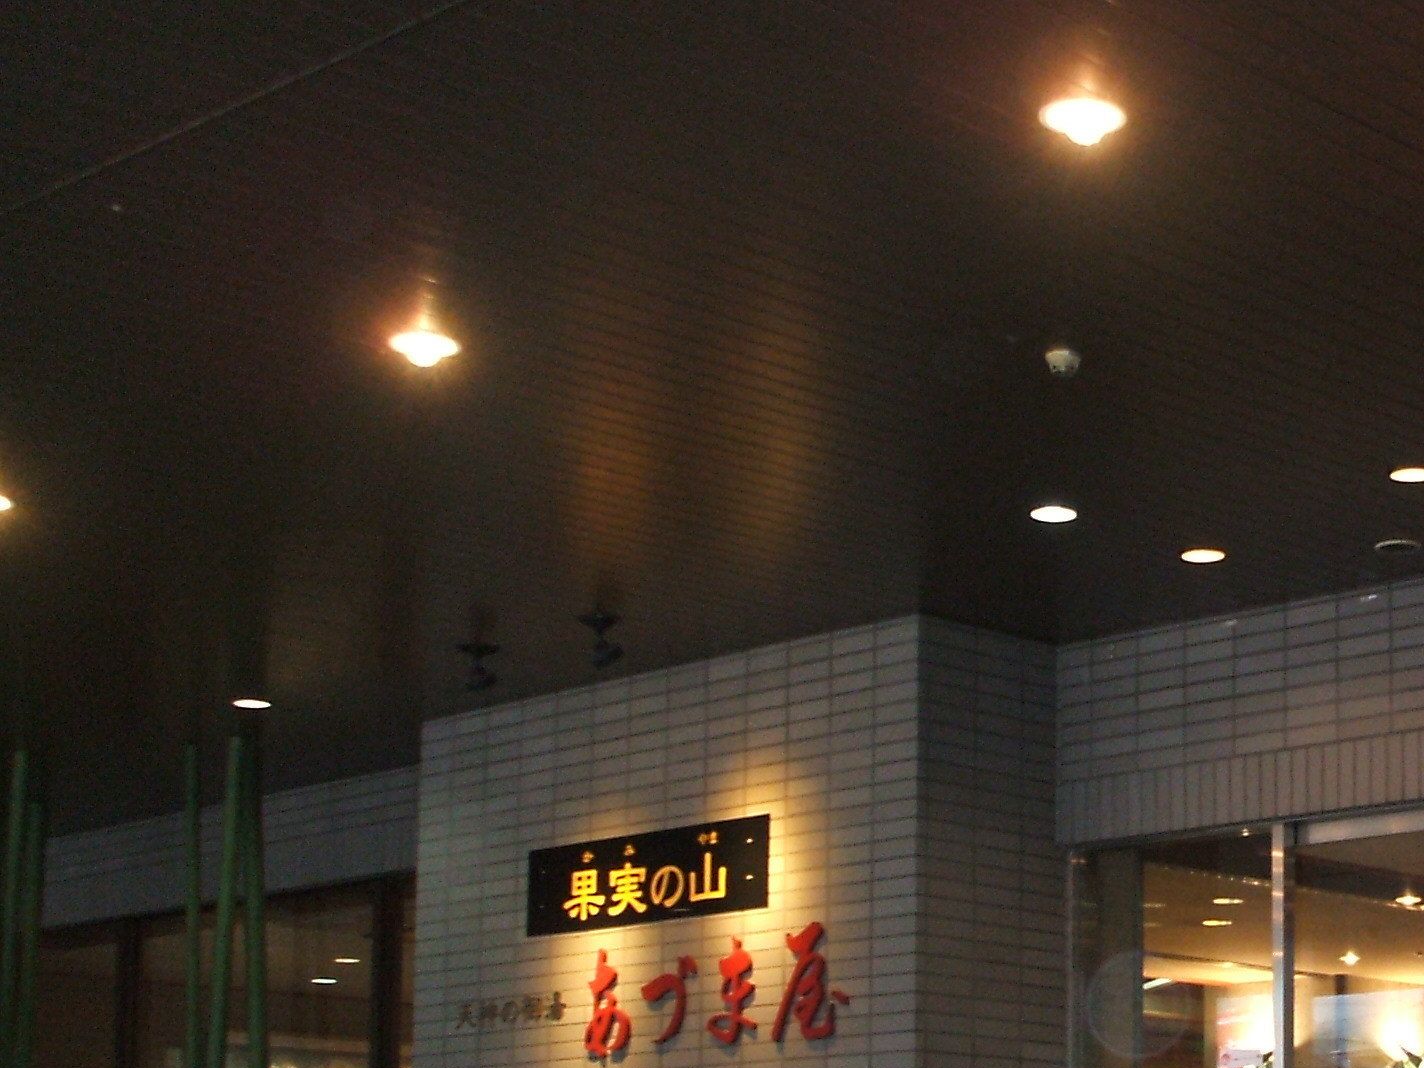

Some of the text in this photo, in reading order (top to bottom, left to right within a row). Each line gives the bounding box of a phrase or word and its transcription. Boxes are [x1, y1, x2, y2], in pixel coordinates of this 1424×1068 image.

[563, 853, 726, 921] 果実の山
[584, 922, 850, 1058] あづま屋
